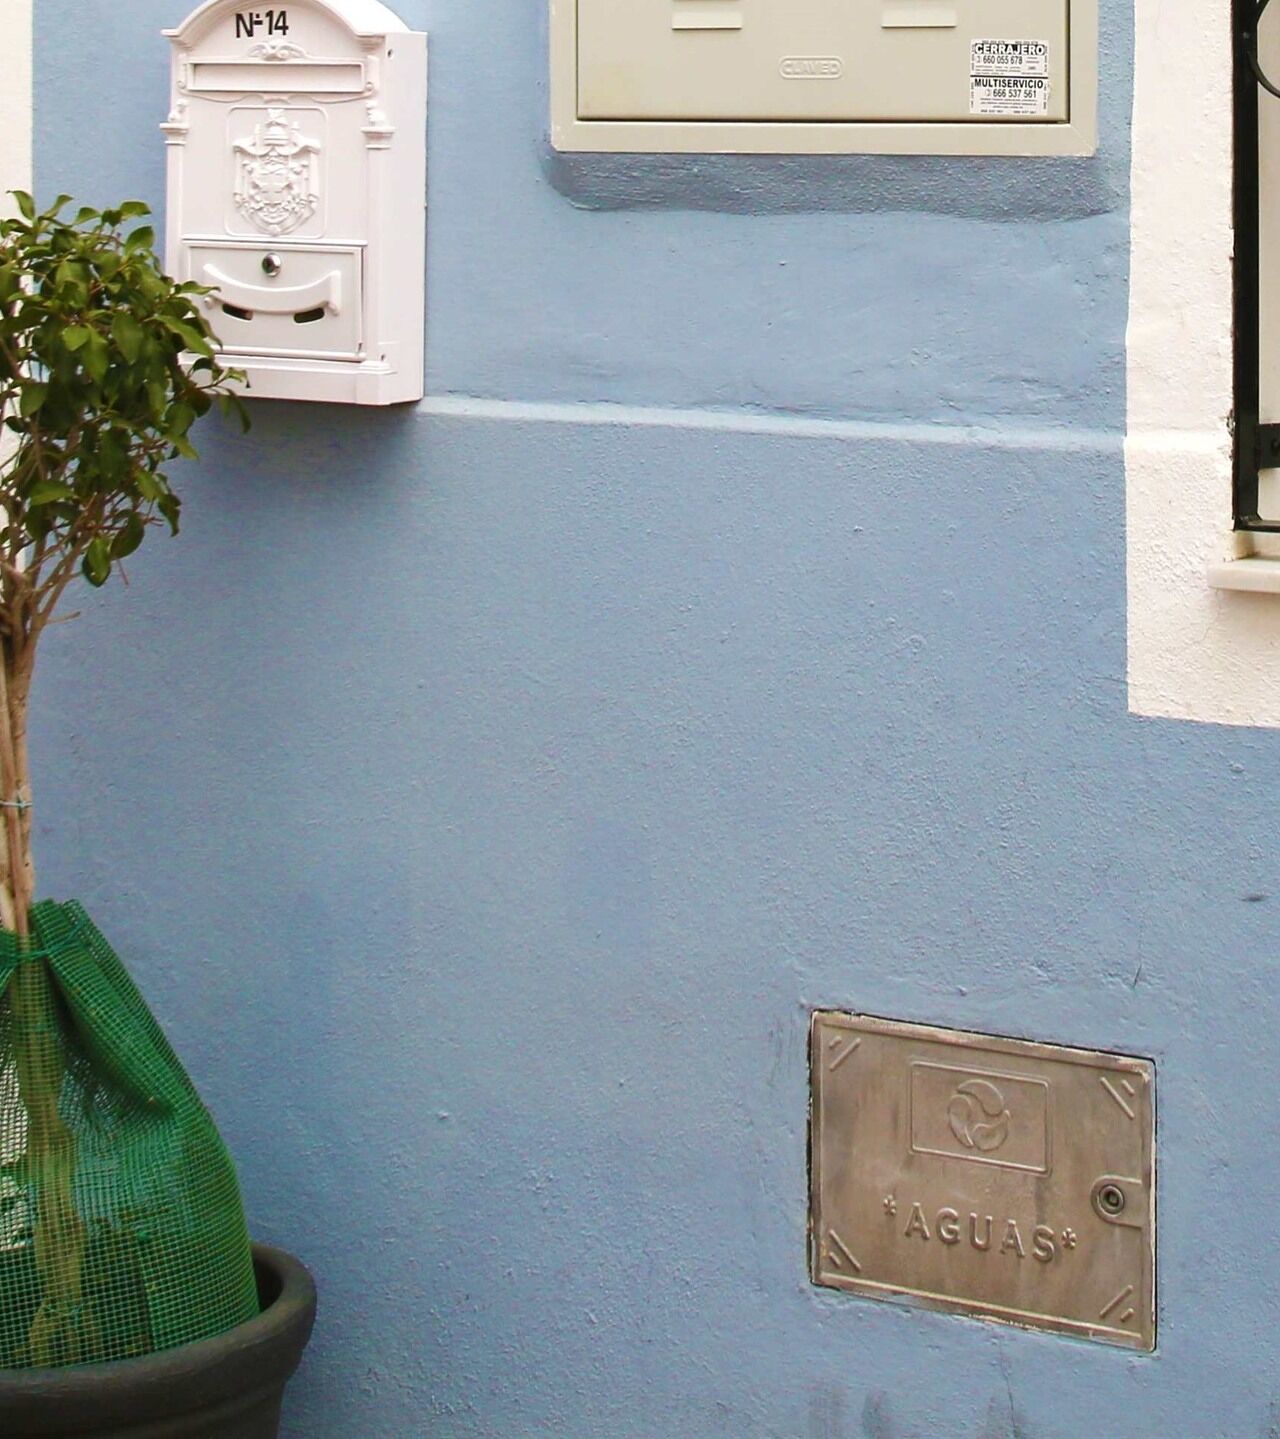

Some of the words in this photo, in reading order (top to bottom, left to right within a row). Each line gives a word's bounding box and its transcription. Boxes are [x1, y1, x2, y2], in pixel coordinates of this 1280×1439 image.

[975, 44, 1044, 56] CERRAJERO
[983, 55, 995, 64] 660
[1010, 56, 1023, 64] 678
[974, 78, 1044, 89] MULTISERVICIO
[993, 89, 1007, 98] 666
[1008, 89, 1022, 98] 537
[904, 1202, 1056, 1262] AGUAS
